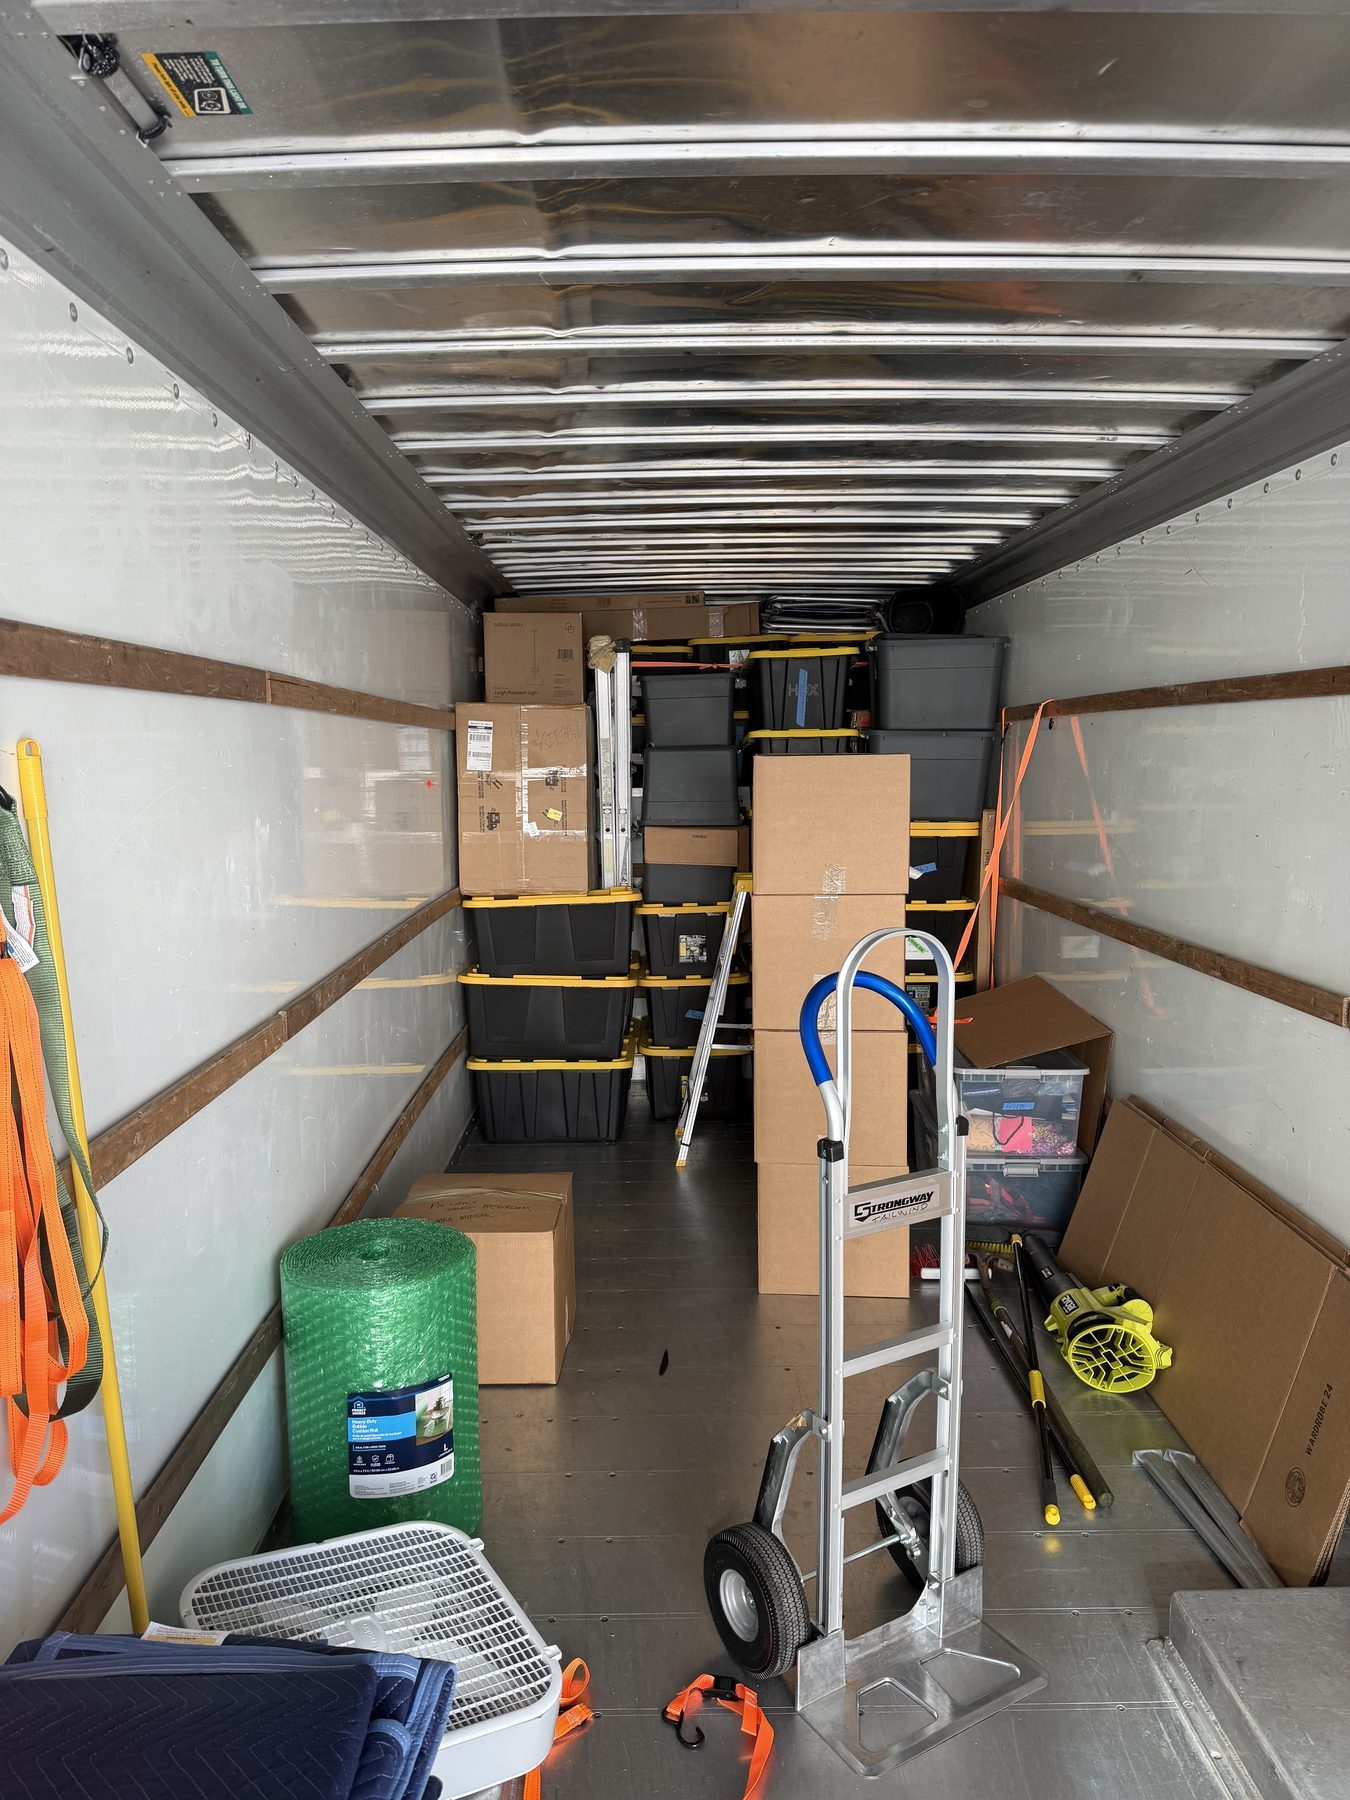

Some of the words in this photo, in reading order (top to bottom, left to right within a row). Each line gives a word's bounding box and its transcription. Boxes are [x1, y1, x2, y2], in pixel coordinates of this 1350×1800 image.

[788, 683, 819, 697] HX
[854, 1191, 934, 1222] STRONGWAY
[872, 1202, 929, 1223] TAILWIND
[1061, 1294, 1077, 1312] RYOBI
[1304, 1399, 1329, 1456] WARDROBE
[1323, 1383, 1334, 1400] 24
